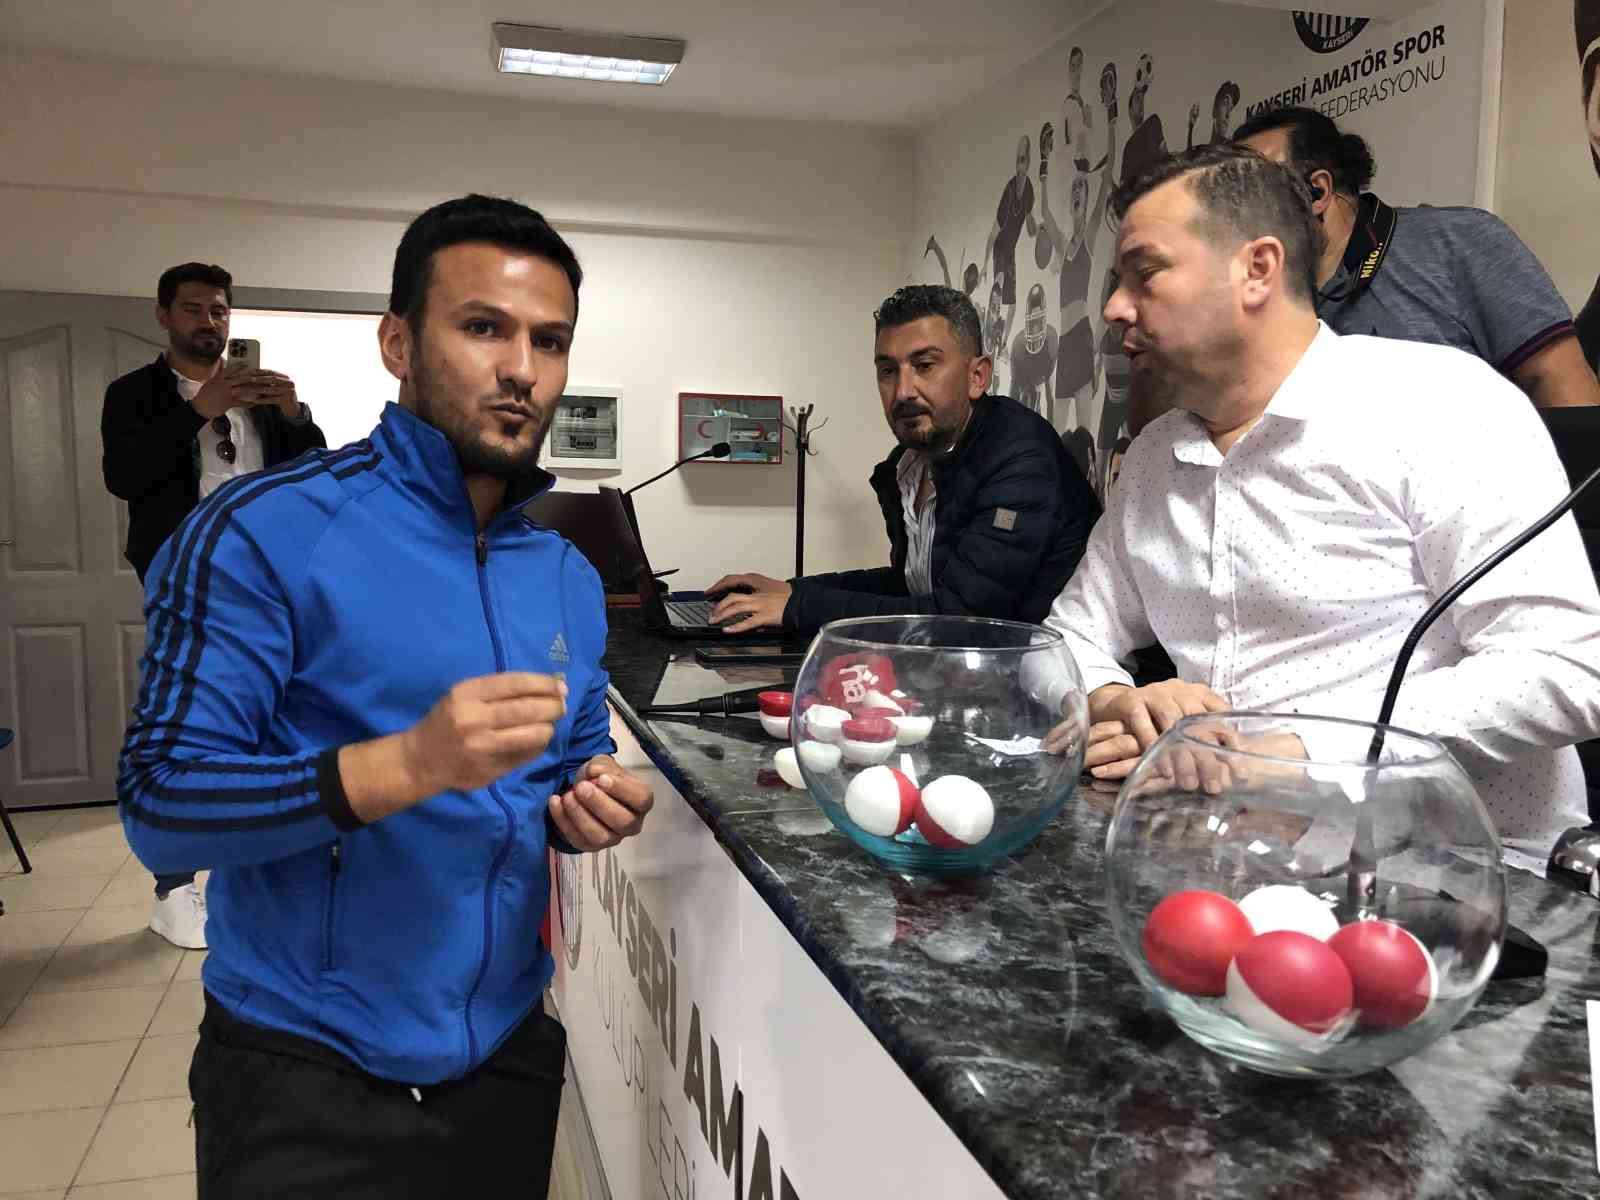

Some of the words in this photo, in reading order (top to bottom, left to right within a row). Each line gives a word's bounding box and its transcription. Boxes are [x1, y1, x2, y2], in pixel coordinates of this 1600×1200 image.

[1310, 48, 1388, 99] AMATÖR
[1392, 25, 1445, 65] SPOR
[1320, 55, 1445, 119] FEDERASYONU
